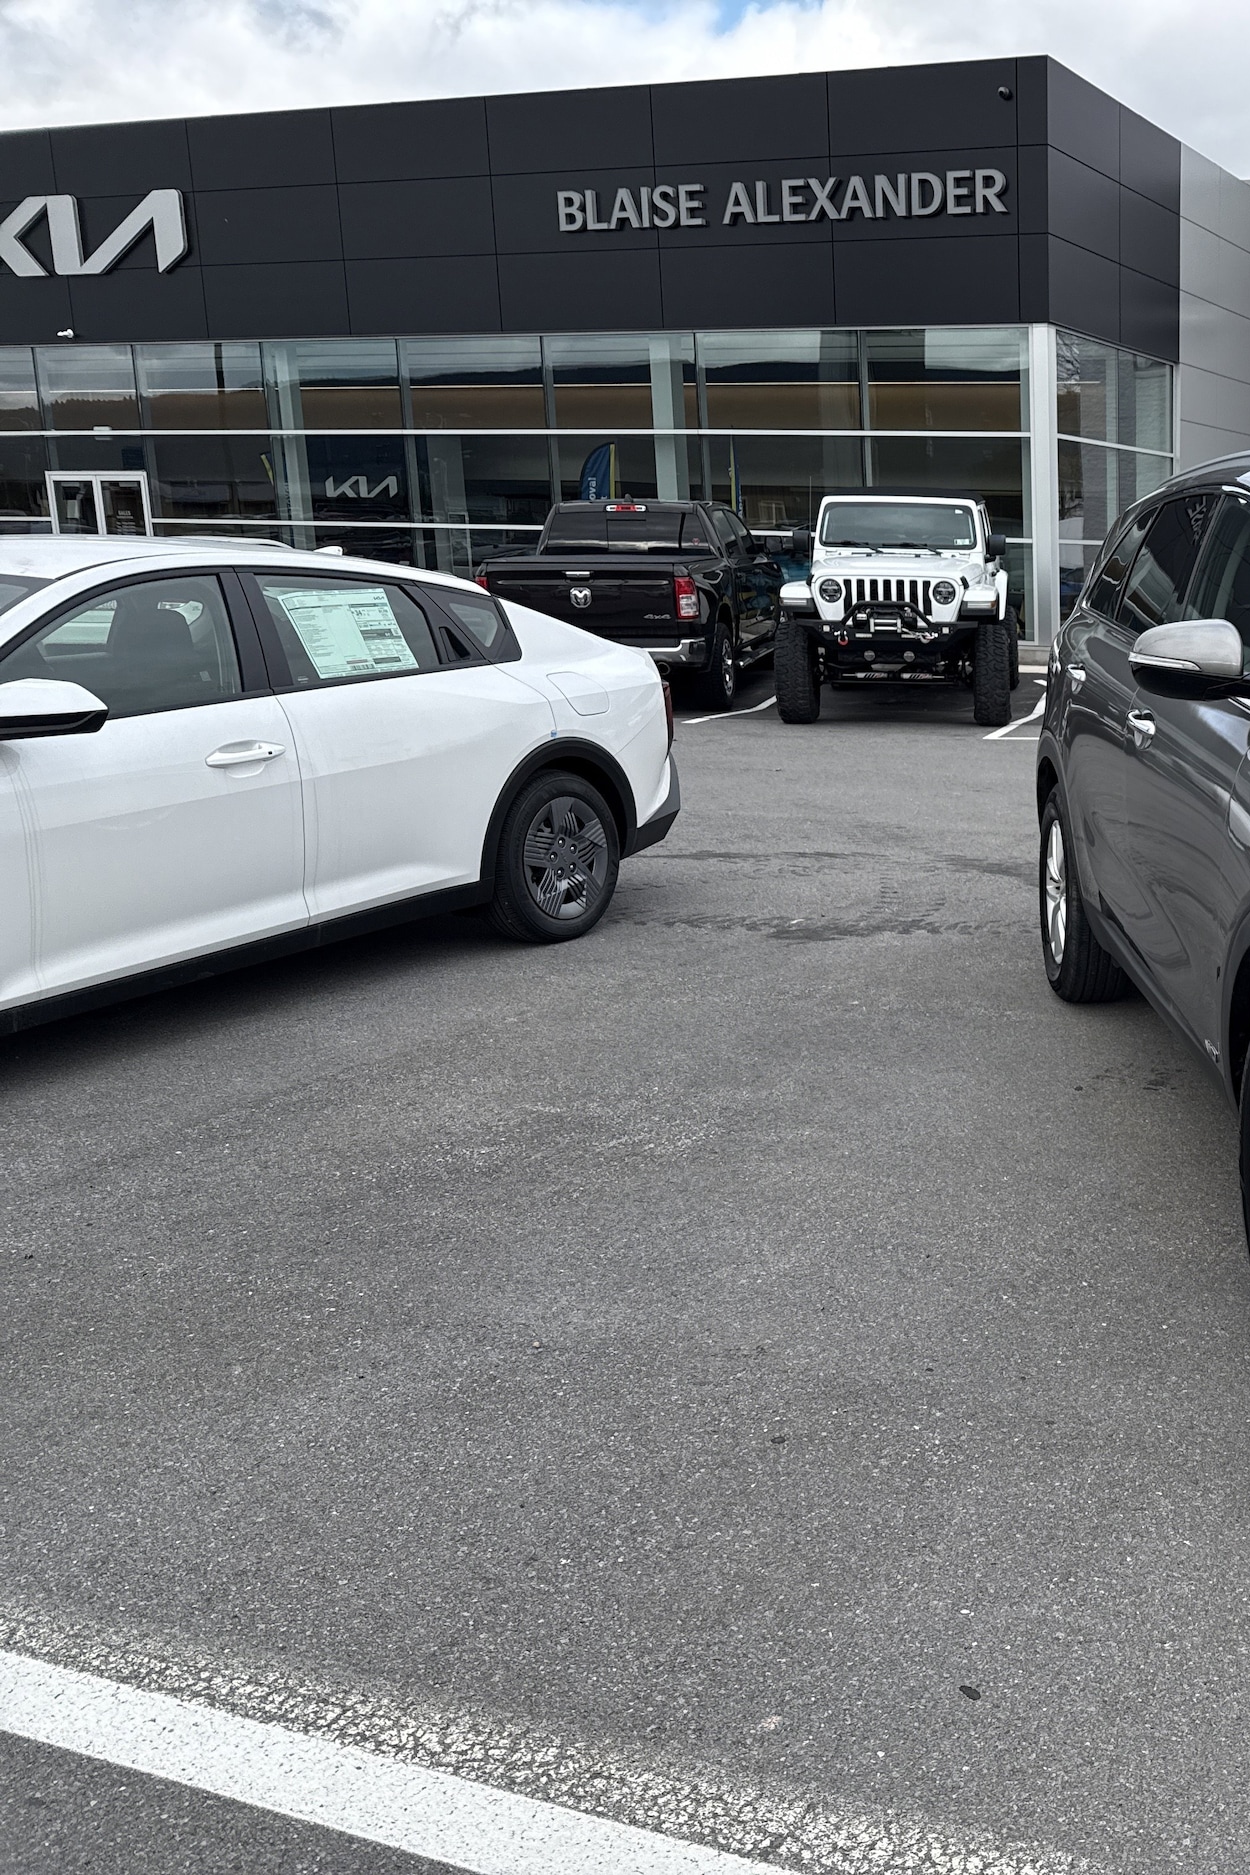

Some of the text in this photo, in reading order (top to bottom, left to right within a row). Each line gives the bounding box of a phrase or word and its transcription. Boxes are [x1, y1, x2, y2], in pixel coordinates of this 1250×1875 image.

[556, 168, 1009, 233] BLAISE ALEXANDER
[325, 475, 398, 498] KIA
[588, 477, 597, 500] oval
